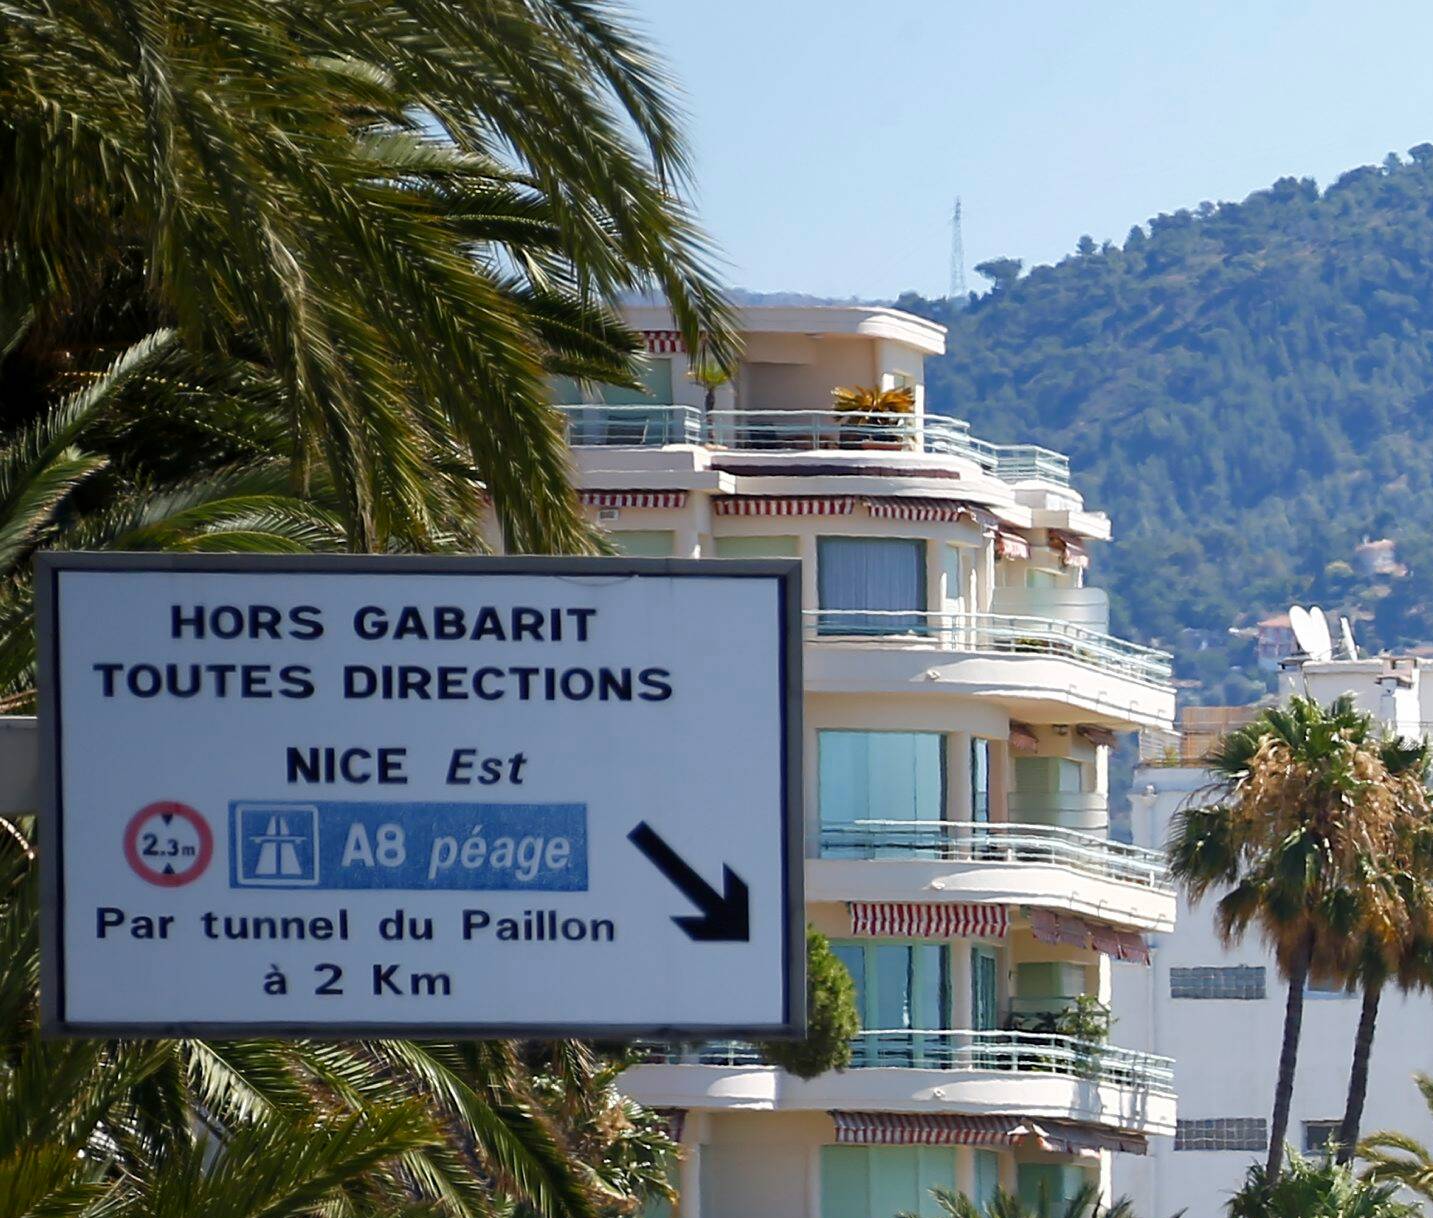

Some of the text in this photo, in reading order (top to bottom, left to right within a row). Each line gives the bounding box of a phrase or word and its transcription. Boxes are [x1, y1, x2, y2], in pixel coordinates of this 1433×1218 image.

[172, 605, 596, 641] HORS GABARIT
[93, 664, 672, 701] TOUTES DIRECTIONS
[287, 747, 527, 784] NICE Est
[342, 823, 571, 881] A8 péage
[97, 908, 614, 941] Par tunnel du Paillon
[264, 964, 450, 995] à 2 Km
